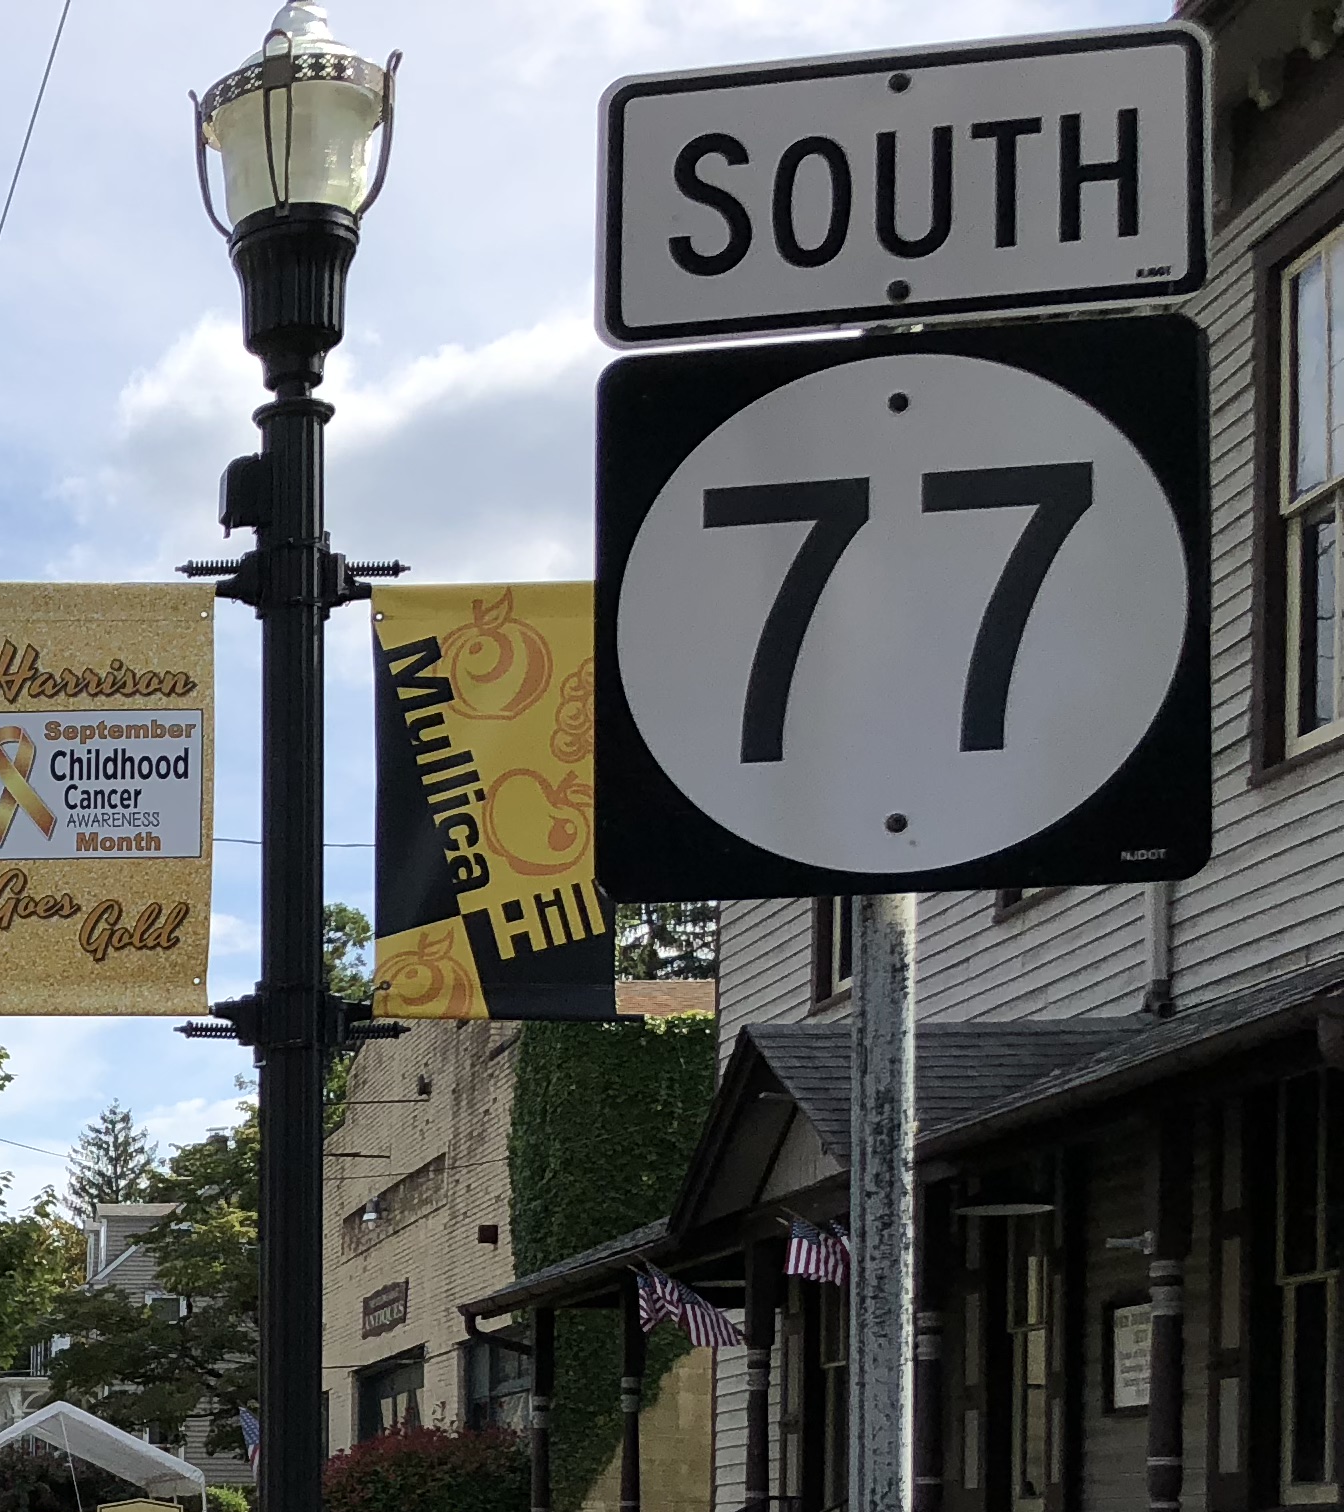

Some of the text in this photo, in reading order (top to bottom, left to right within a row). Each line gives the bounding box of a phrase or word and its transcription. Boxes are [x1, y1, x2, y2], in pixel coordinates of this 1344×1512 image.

[669, 108, 1139, 277] SOUTH
[703, 461, 1094, 764] 77
[44, 719, 197, 745] September
[50, 747, 190, 781] Childhood
[384, 635, 490, 895] Mullica
[64, 784, 142, 810] Cancer
[67, 812, 160, 828] AWARENESS
[76, 831, 162, 852] Month
[79, 898, 191, 962] Gold
[487, 877, 606, 960] Hill
